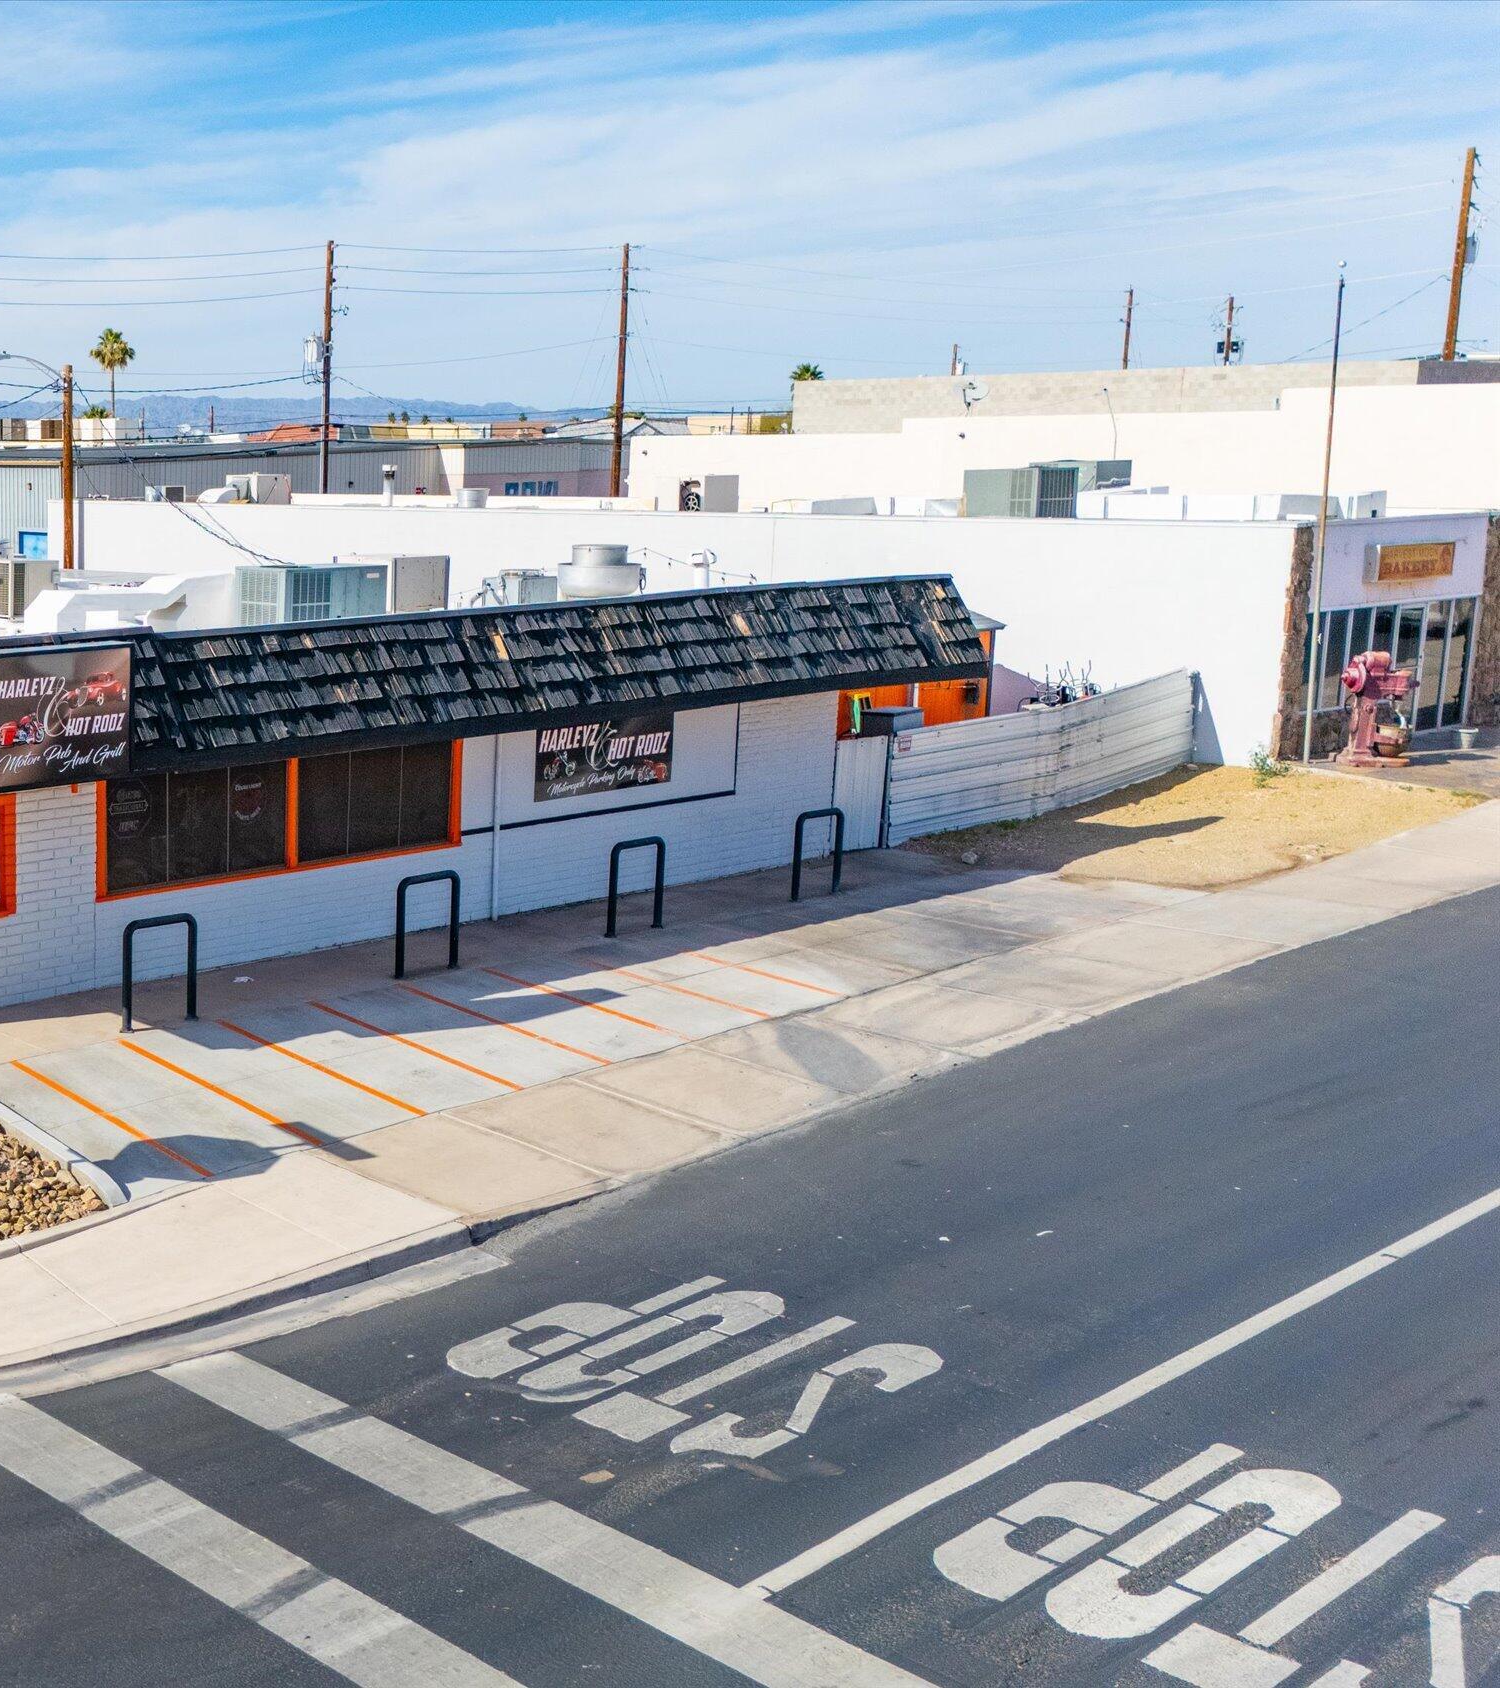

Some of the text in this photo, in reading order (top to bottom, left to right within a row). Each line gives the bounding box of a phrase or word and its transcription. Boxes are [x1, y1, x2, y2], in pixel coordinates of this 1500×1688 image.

[64, 712, 126, 737] HOT RODZ
[538, 723, 600, 753] HARLEYZ
[43, 743, 72, 765] Pub
[59, 748, 94, 773] And
[93, 741, 127, 767] Grill
[607, 731, 671, 760] HOT RODZ
[586, 771, 616, 788] Parking
[617, 764, 636, 780] Only
[446, 1275, 944, 1459] STOP
